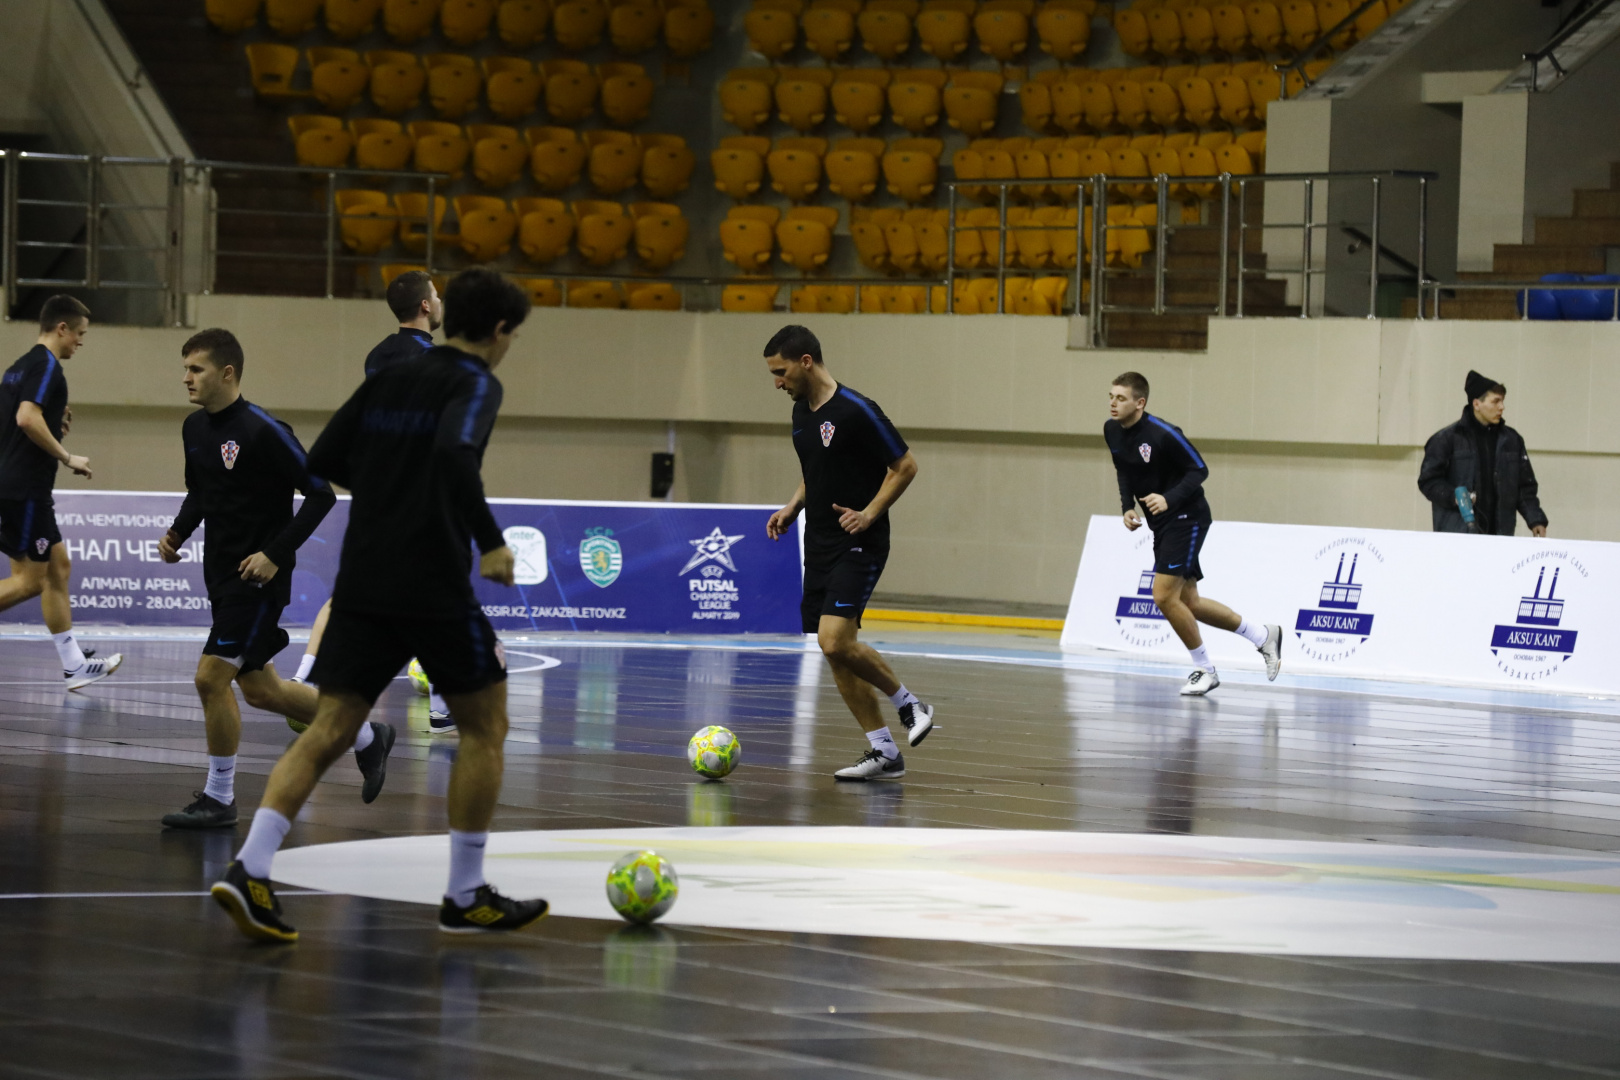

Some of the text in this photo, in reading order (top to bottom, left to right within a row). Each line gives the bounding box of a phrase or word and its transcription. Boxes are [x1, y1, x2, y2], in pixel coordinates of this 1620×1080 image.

[86, 514, 175, 528] ЧЕМПИОНОВ
[509, 530, 536, 540] inter
[65, 538, 121, 561] НАЛ
[1511, 550, 1589, 578] СВЕКЛОВИЧНЫЙ САХАР
[80, 577, 191, 592] АЛМАТЫ АРЕНА
[689, 579, 739, 592] FUTSAL
[69, 594, 133, 609] 5.04.2019
[690, 592, 739, 601] CHAMPIONS
[531, 606, 627, 619] ZAKAZBILETOV.KZ
[698, 601, 732, 610] LEAGUE
[1129, 602, 1151, 615] AKSU
[1310, 615, 1360, 630] AKSU KANT
[1507, 631, 1561, 647] AKSU KANT
[1301, 642, 1356, 662] КАЗАХСТАН
[1497, 660, 1558, 681] КАЗАХСТАН
